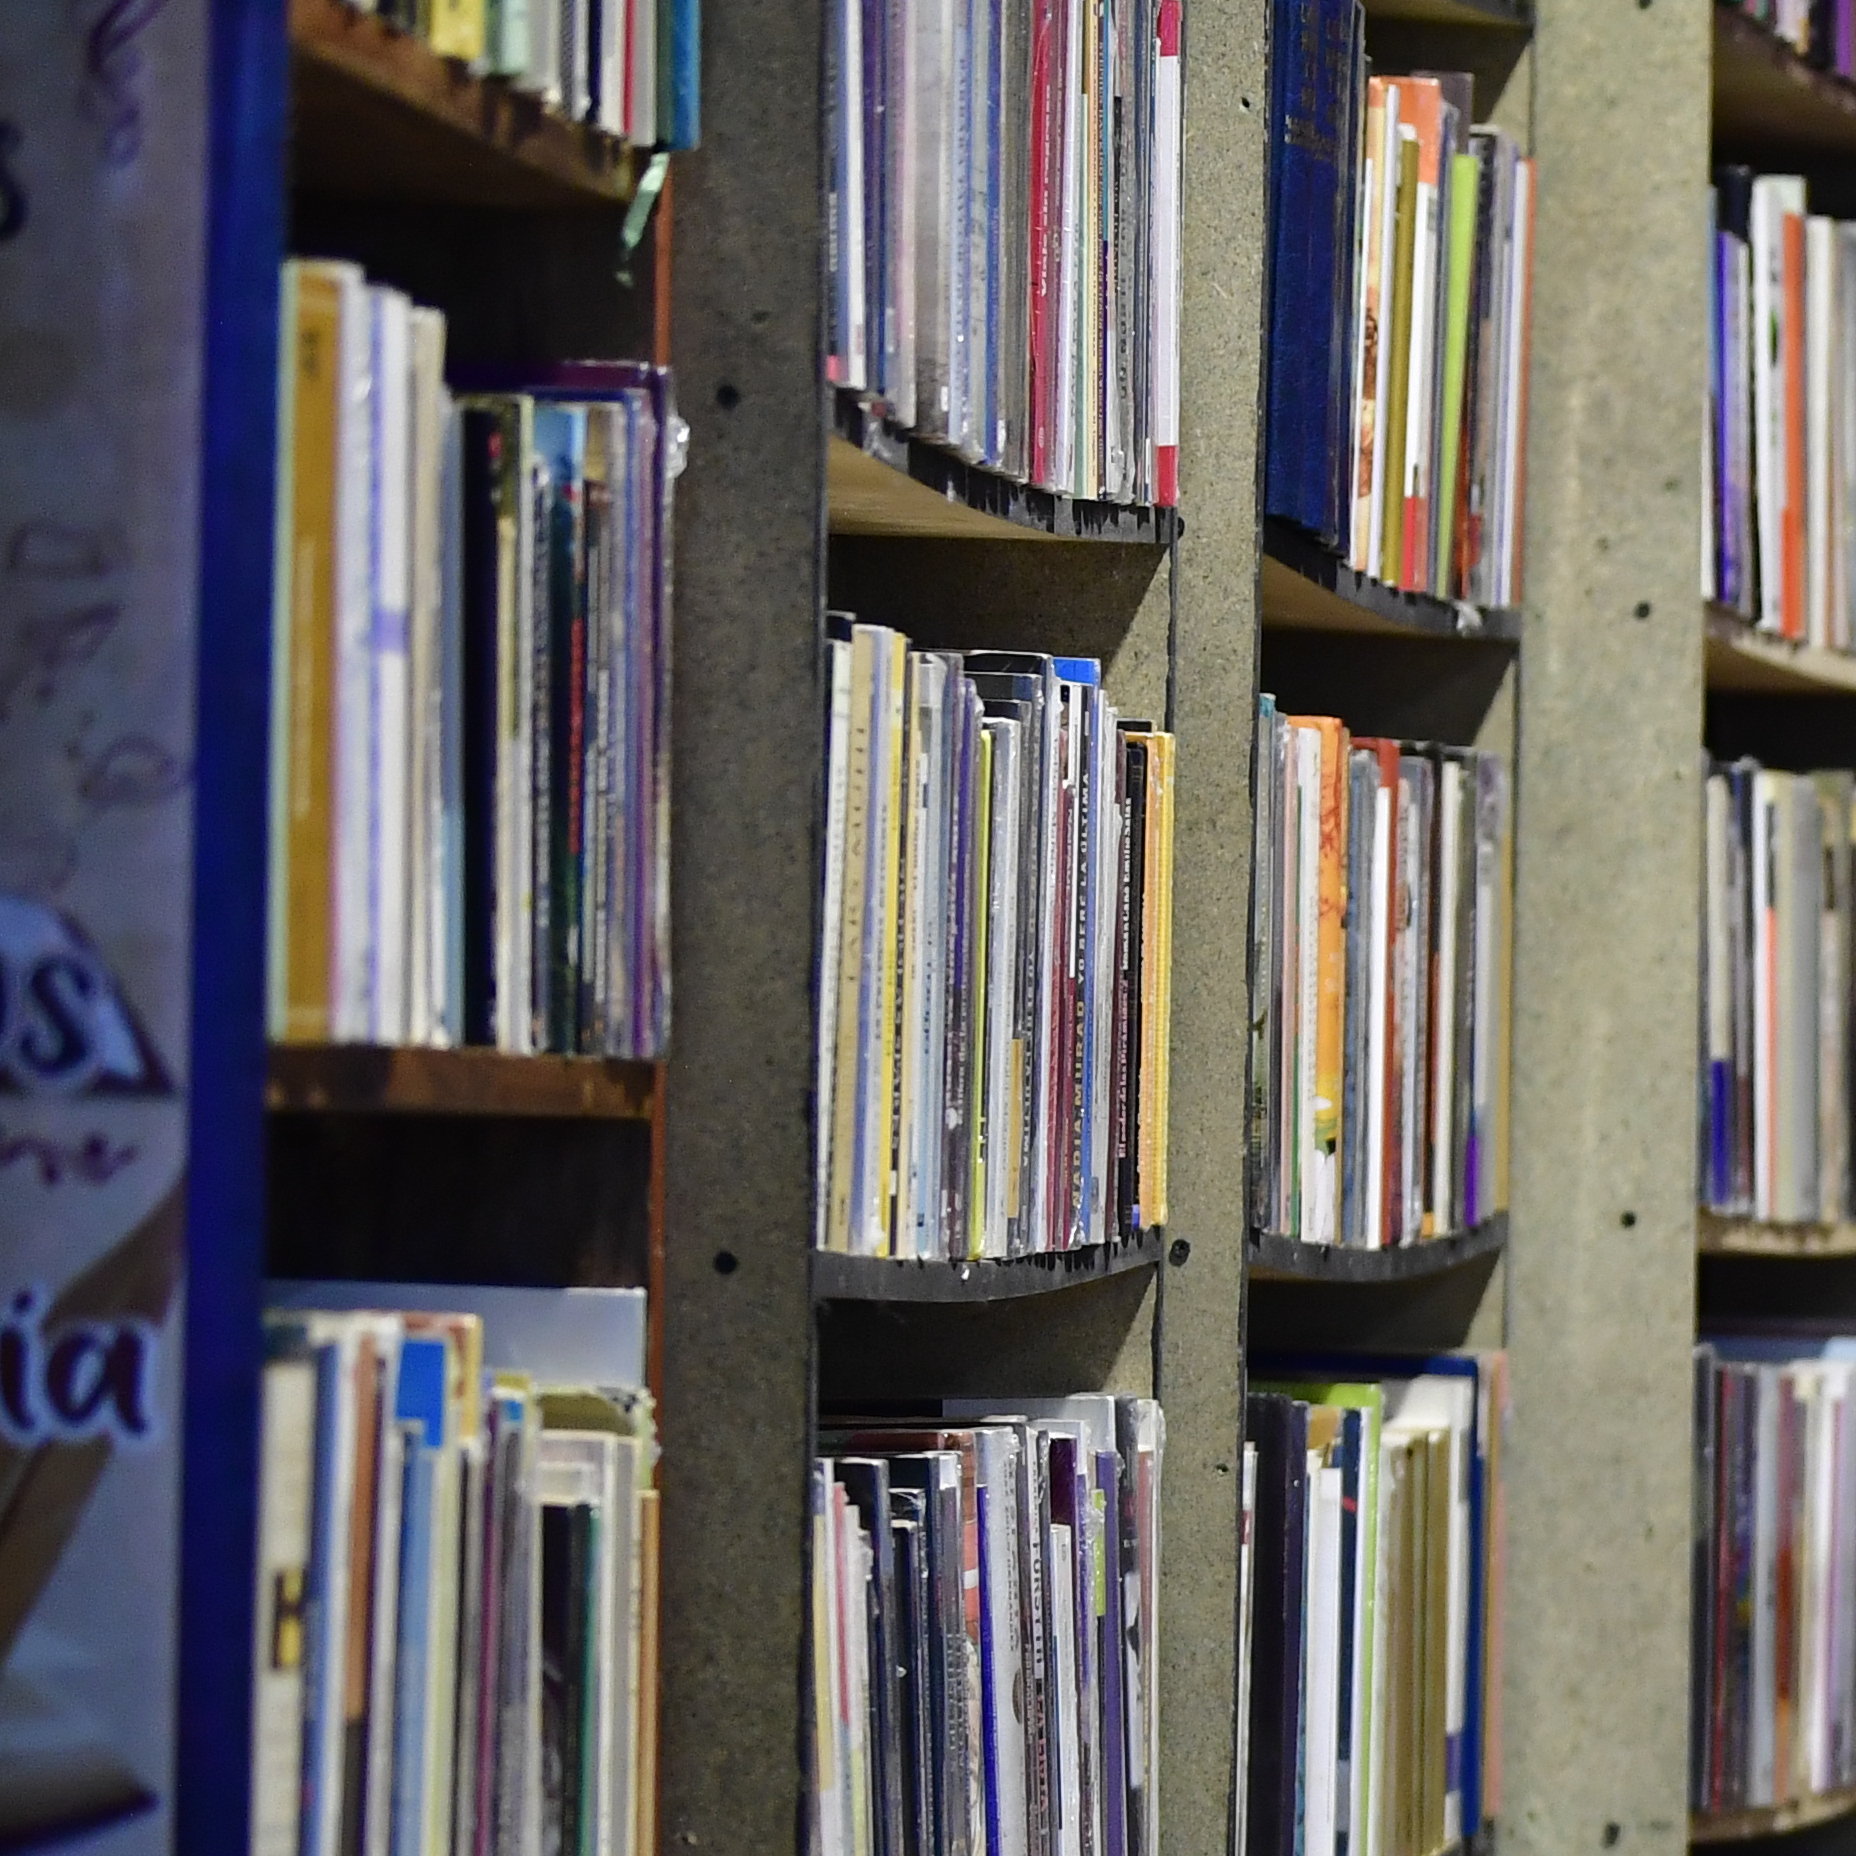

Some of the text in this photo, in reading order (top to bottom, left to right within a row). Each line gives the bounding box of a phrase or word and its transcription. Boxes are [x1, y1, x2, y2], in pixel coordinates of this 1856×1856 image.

[1043, 84, 1051, 184] regreso
[1078, 772, 1089, 853] ÚLTIMA
[1122, 798, 1132, 837] Salas
[1079, 861, 1087, 887] LA
[1122, 836, 1131, 883] Emilio
[1077, 958, 1085, 984] YO
[1074, 1001, 1085, 1106] MURAD
[1118, 1103, 1128, 1142] poder
[1071, 1119, 1083, 1207] NADIA
